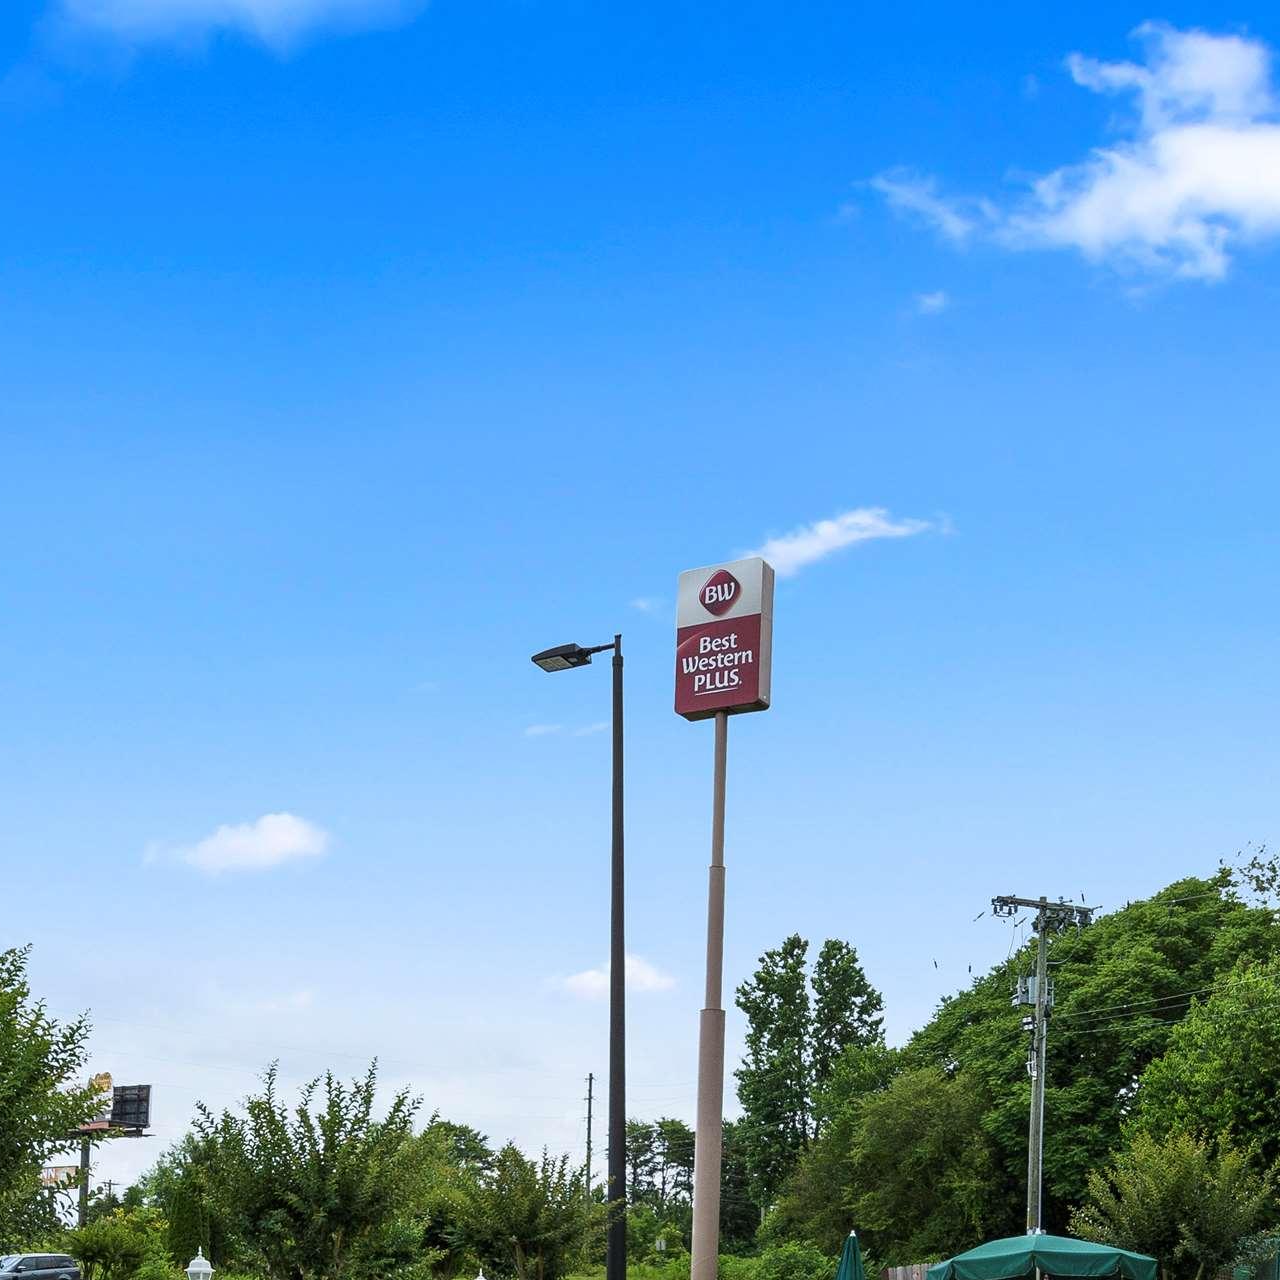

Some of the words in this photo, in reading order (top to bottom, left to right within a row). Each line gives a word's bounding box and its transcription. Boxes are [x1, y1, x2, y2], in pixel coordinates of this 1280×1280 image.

[705, 582, 735, 604] BW
[699, 633, 738, 654] Best
[682, 650, 753, 674] Western
